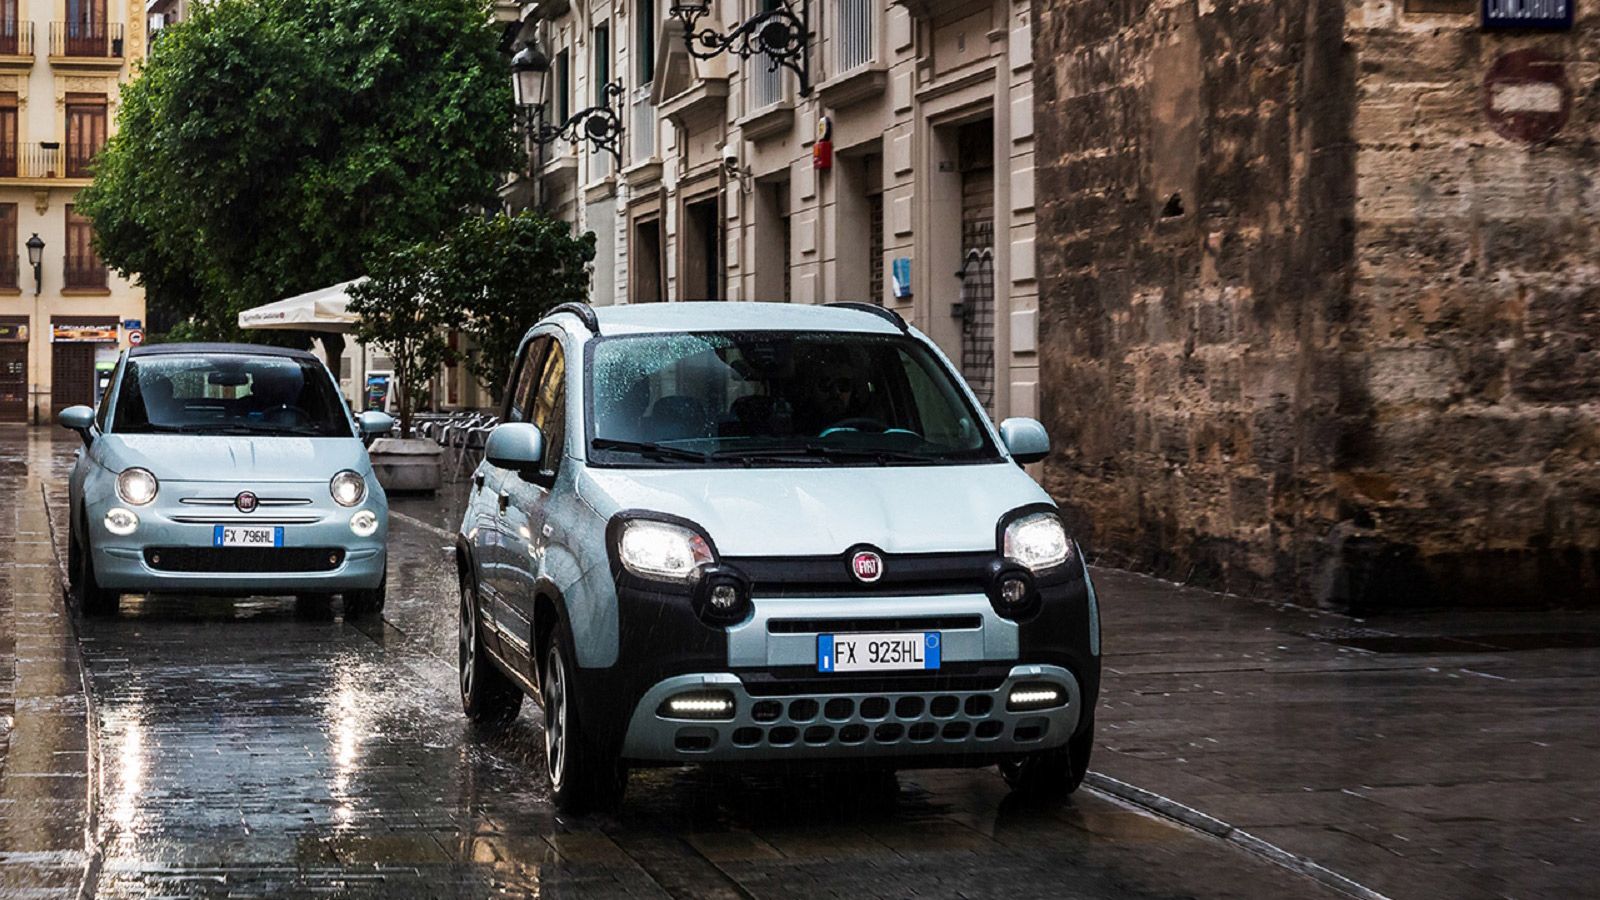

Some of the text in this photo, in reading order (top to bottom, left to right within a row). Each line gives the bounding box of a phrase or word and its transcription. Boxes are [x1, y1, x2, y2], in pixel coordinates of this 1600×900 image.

[224, 529, 237, 542] FX
[243, 530, 274, 543] 796HL
[858, 559, 876, 574] FIAT
[835, 641, 857, 664] FX
[868, 640, 924, 663] 923HL
